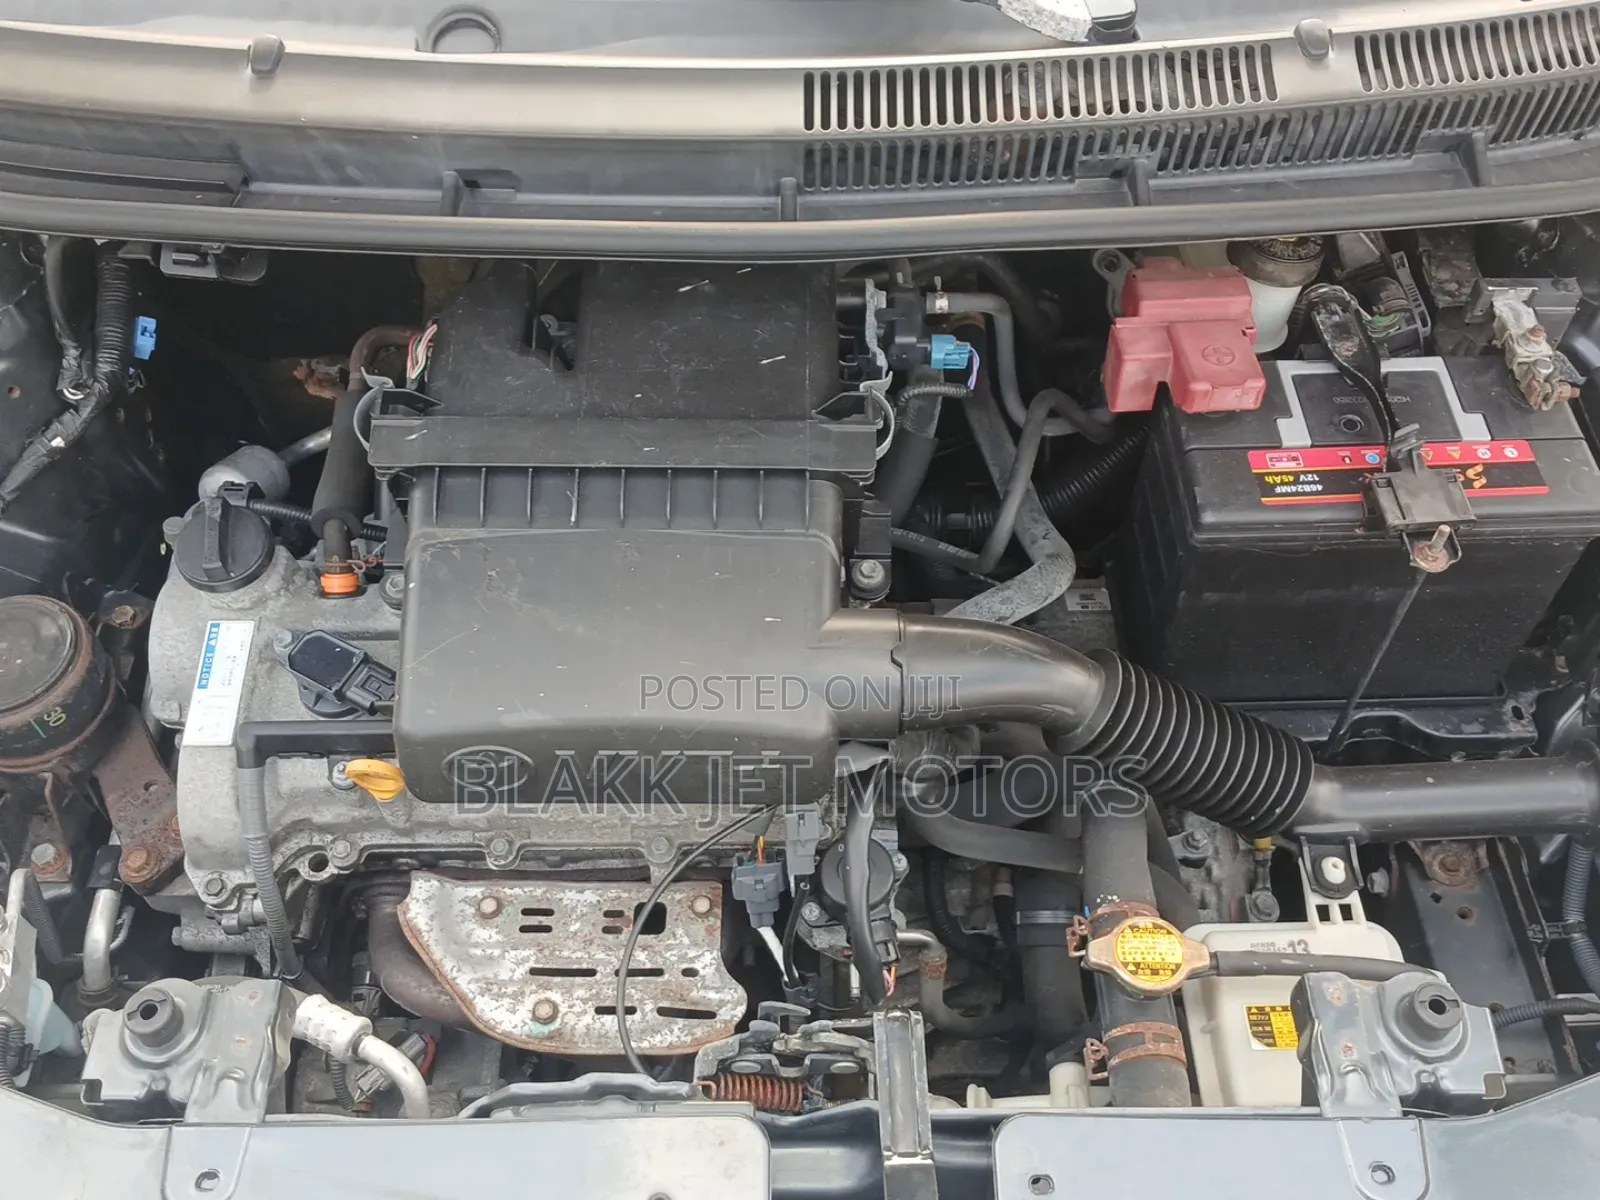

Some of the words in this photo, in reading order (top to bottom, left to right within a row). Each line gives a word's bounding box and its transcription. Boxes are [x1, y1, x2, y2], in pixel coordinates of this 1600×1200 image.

[1264, 474, 1295, 484] 45Ah
[1299, 473, 1320, 482] 12V
[1274, 484, 1323, 493] 46B24MF
[200, 652, 214, 686] NOTICE
[1139, 962, 1177, 970] ATTENTION
